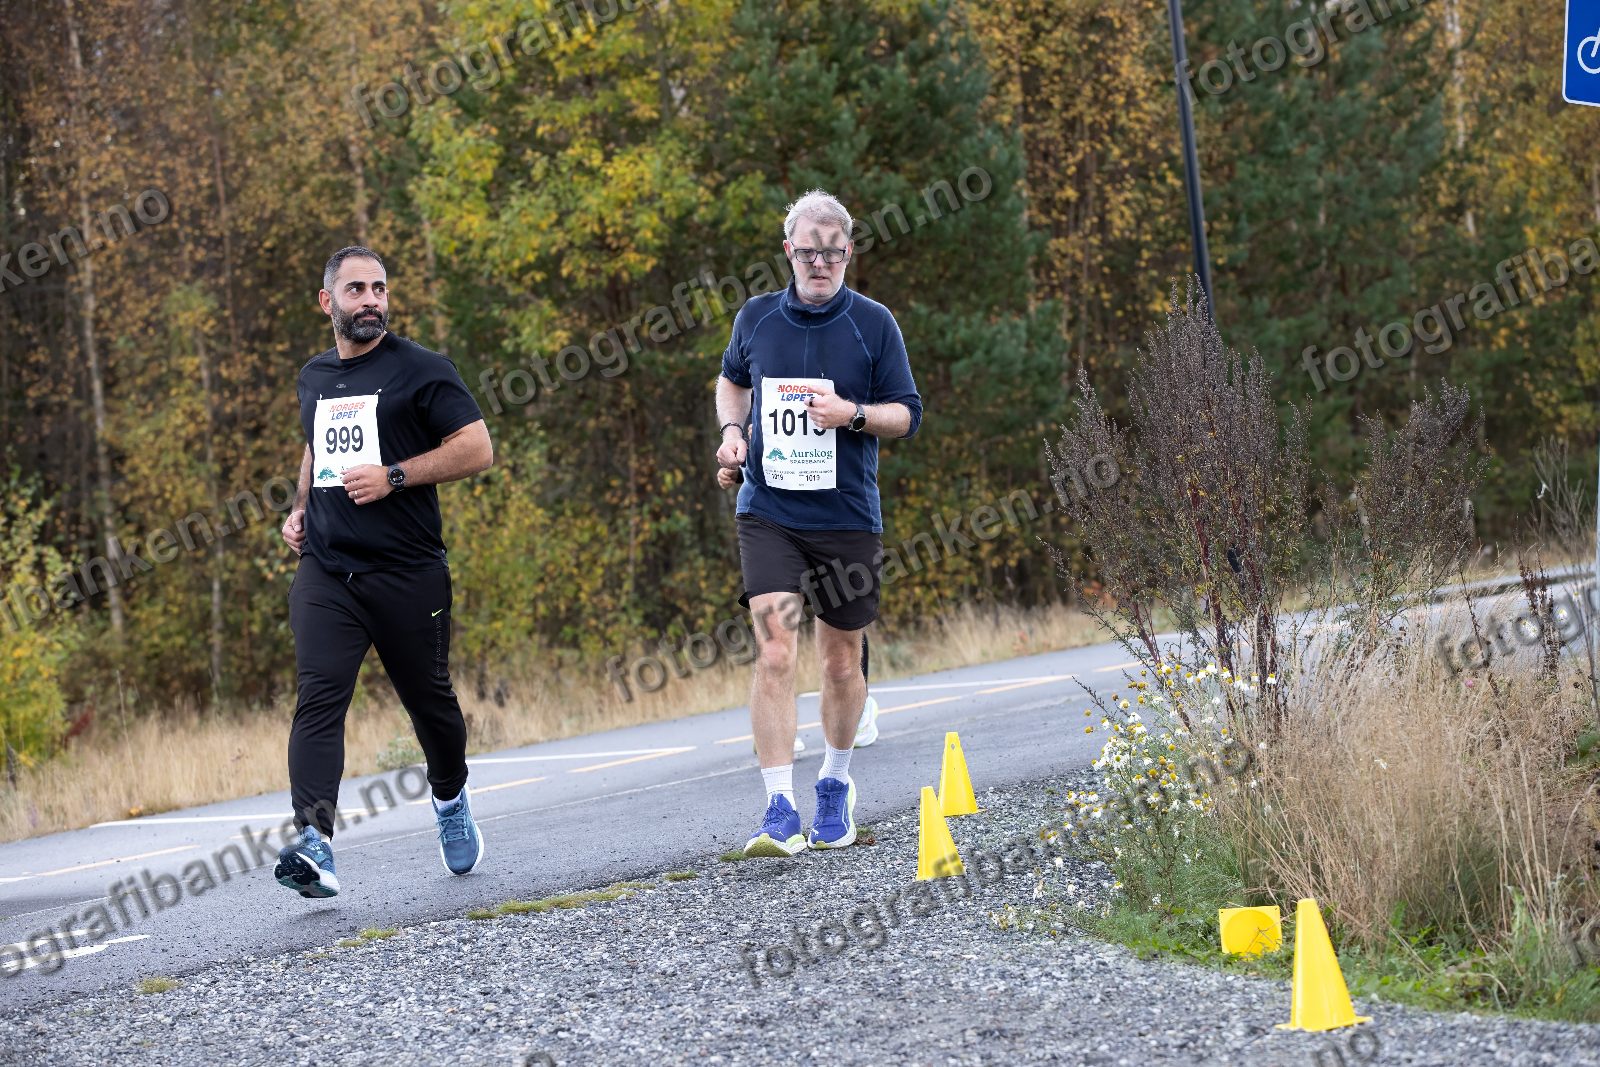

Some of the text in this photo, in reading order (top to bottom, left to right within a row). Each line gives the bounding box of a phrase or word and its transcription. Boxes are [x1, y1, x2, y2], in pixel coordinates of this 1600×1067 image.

[777, 384, 815, 393] NORG
[330, 402, 365, 412] NORGES
[331, 410, 358, 420] LØPET
[326, 425, 363, 454] 999
[790, 449, 833, 460] Aurskog
